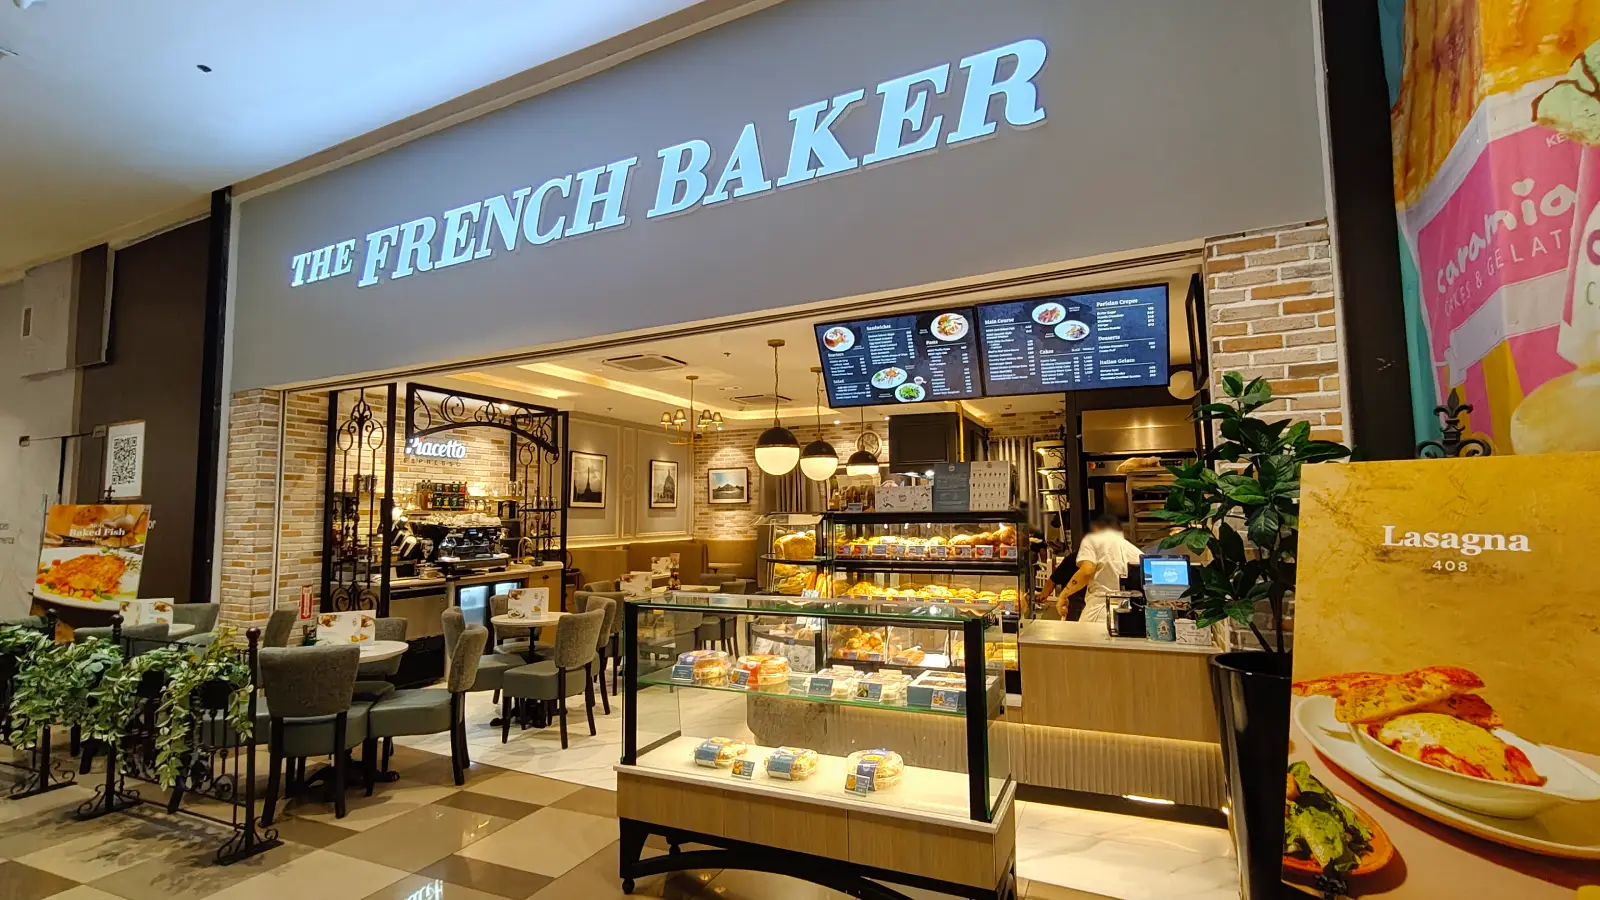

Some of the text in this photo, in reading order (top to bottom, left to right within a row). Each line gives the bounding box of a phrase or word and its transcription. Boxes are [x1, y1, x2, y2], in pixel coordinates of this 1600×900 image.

[290, 38, 1048, 288] THE FRENCH BAKER
[1437, 178, 1577, 293] caramia
[1444, 281, 1471, 316] CAKES
[1487, 229, 1563, 276] GELAT
[69, 528, 126, 537] Baked Fish
[1382, 525, 1532, 556] Lasagna
[1432, 560, 1468, 572] 408
